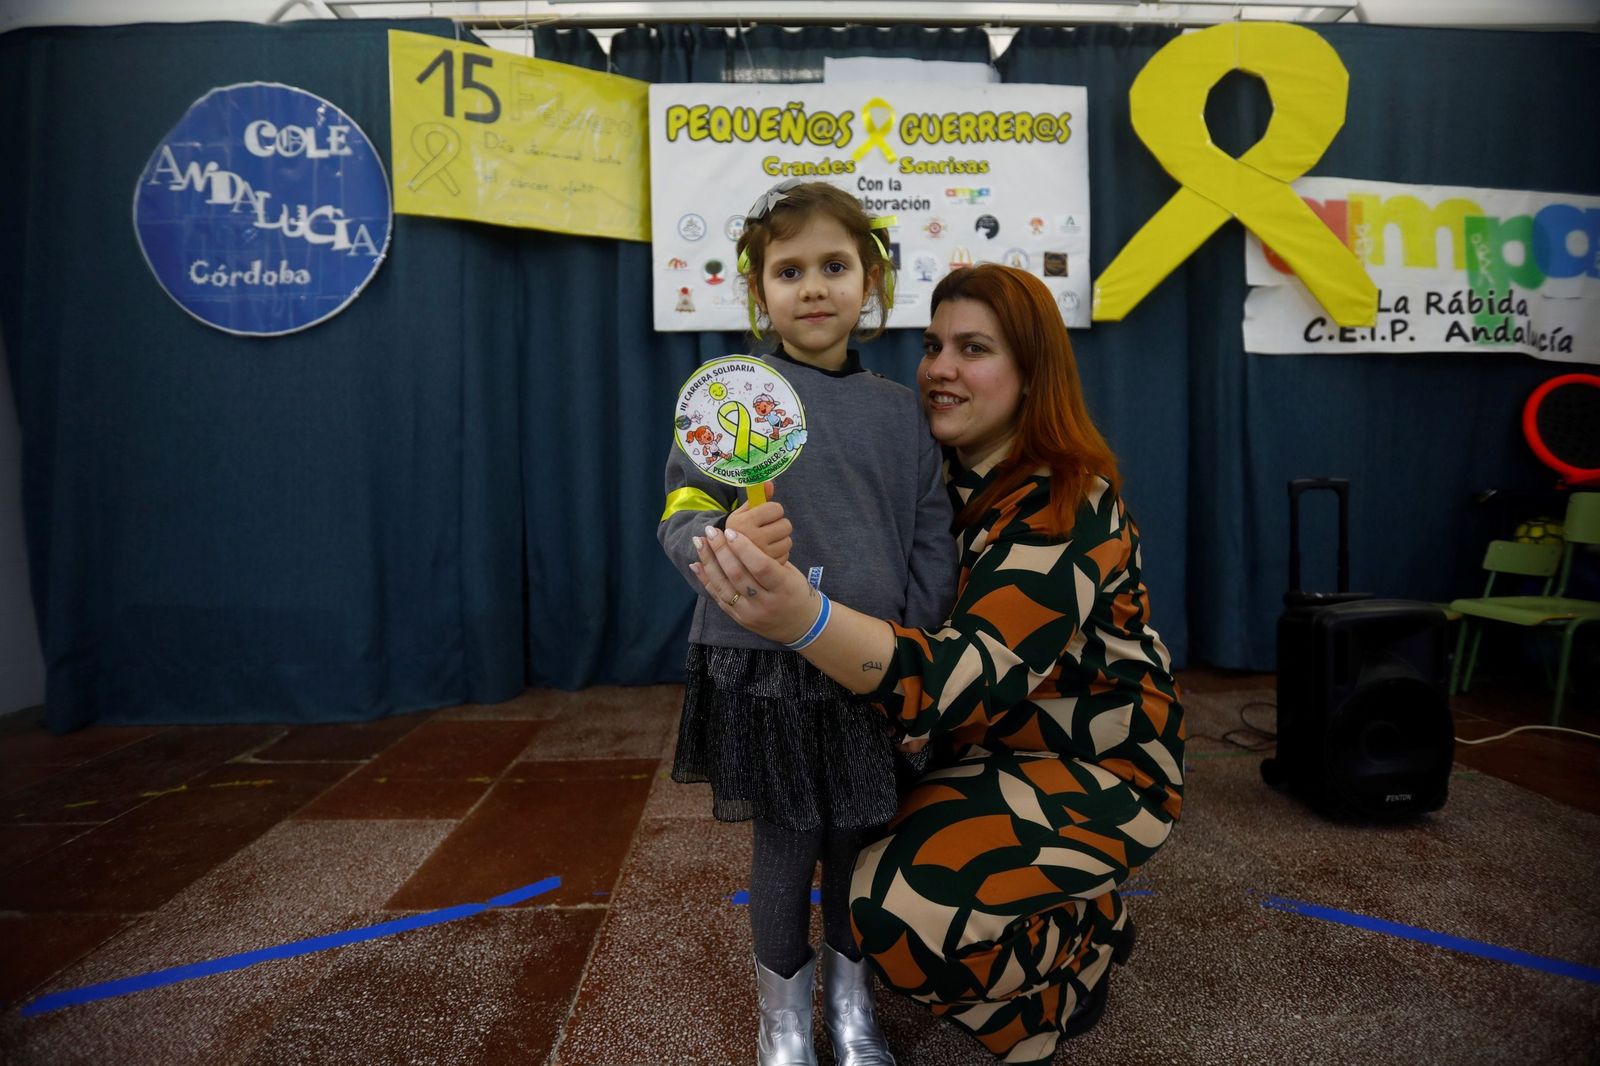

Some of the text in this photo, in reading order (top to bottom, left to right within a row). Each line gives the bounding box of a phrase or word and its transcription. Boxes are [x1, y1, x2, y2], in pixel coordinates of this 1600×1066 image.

[416, 49, 501, 123] 15
[244, 120, 352, 159] COLE
[665, 101, 1073, 149] PEQUEÑ@S GUERRER@S
[762, 156, 990, 177] Grandes Sonrisas
[857, 176, 902, 192] Con la
[862, 195, 931, 211] boración
[189, 260, 311, 287] Córdoba
[1377, 289, 1530, 317] La Rábida
[1304, 317, 1574, 354] C.E.I.P. Andalucía
[680, 364, 755, 412] III CARRERA SOLIDARIA
